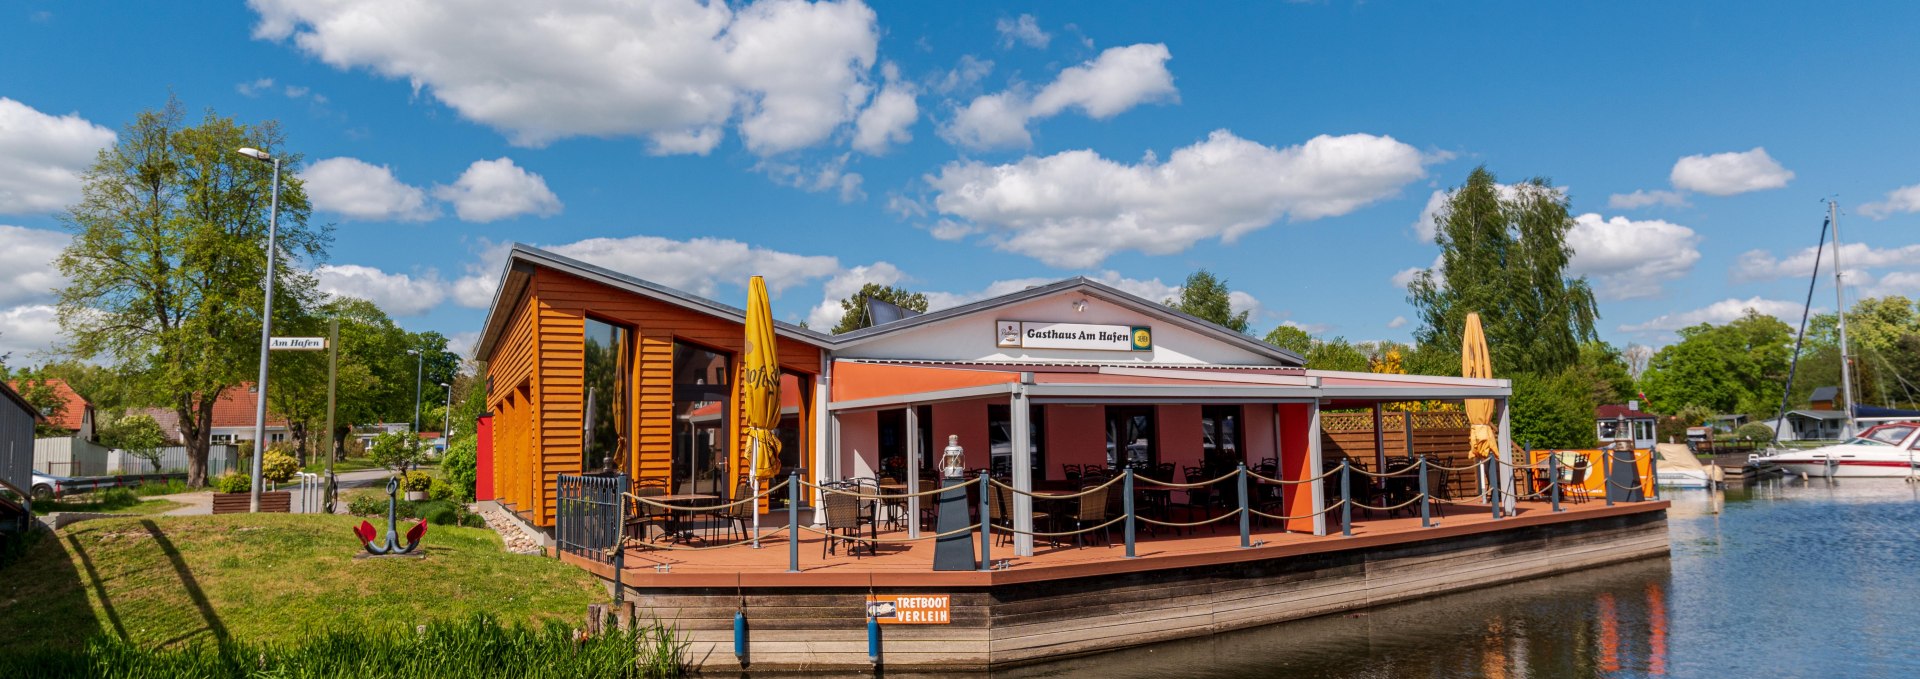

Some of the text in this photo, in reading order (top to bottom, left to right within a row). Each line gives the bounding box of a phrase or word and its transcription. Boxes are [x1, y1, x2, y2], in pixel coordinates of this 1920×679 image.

[1027, 329, 1077, 340] Gasthaus
[1078, 331, 1095, 340] Am
[1099, 331, 1129, 343] Hafen
[290, 339, 319, 348] Hafen
[897, 597, 947, 608] TRETBOOT
[897, 611, 947, 622] VERLEIH
